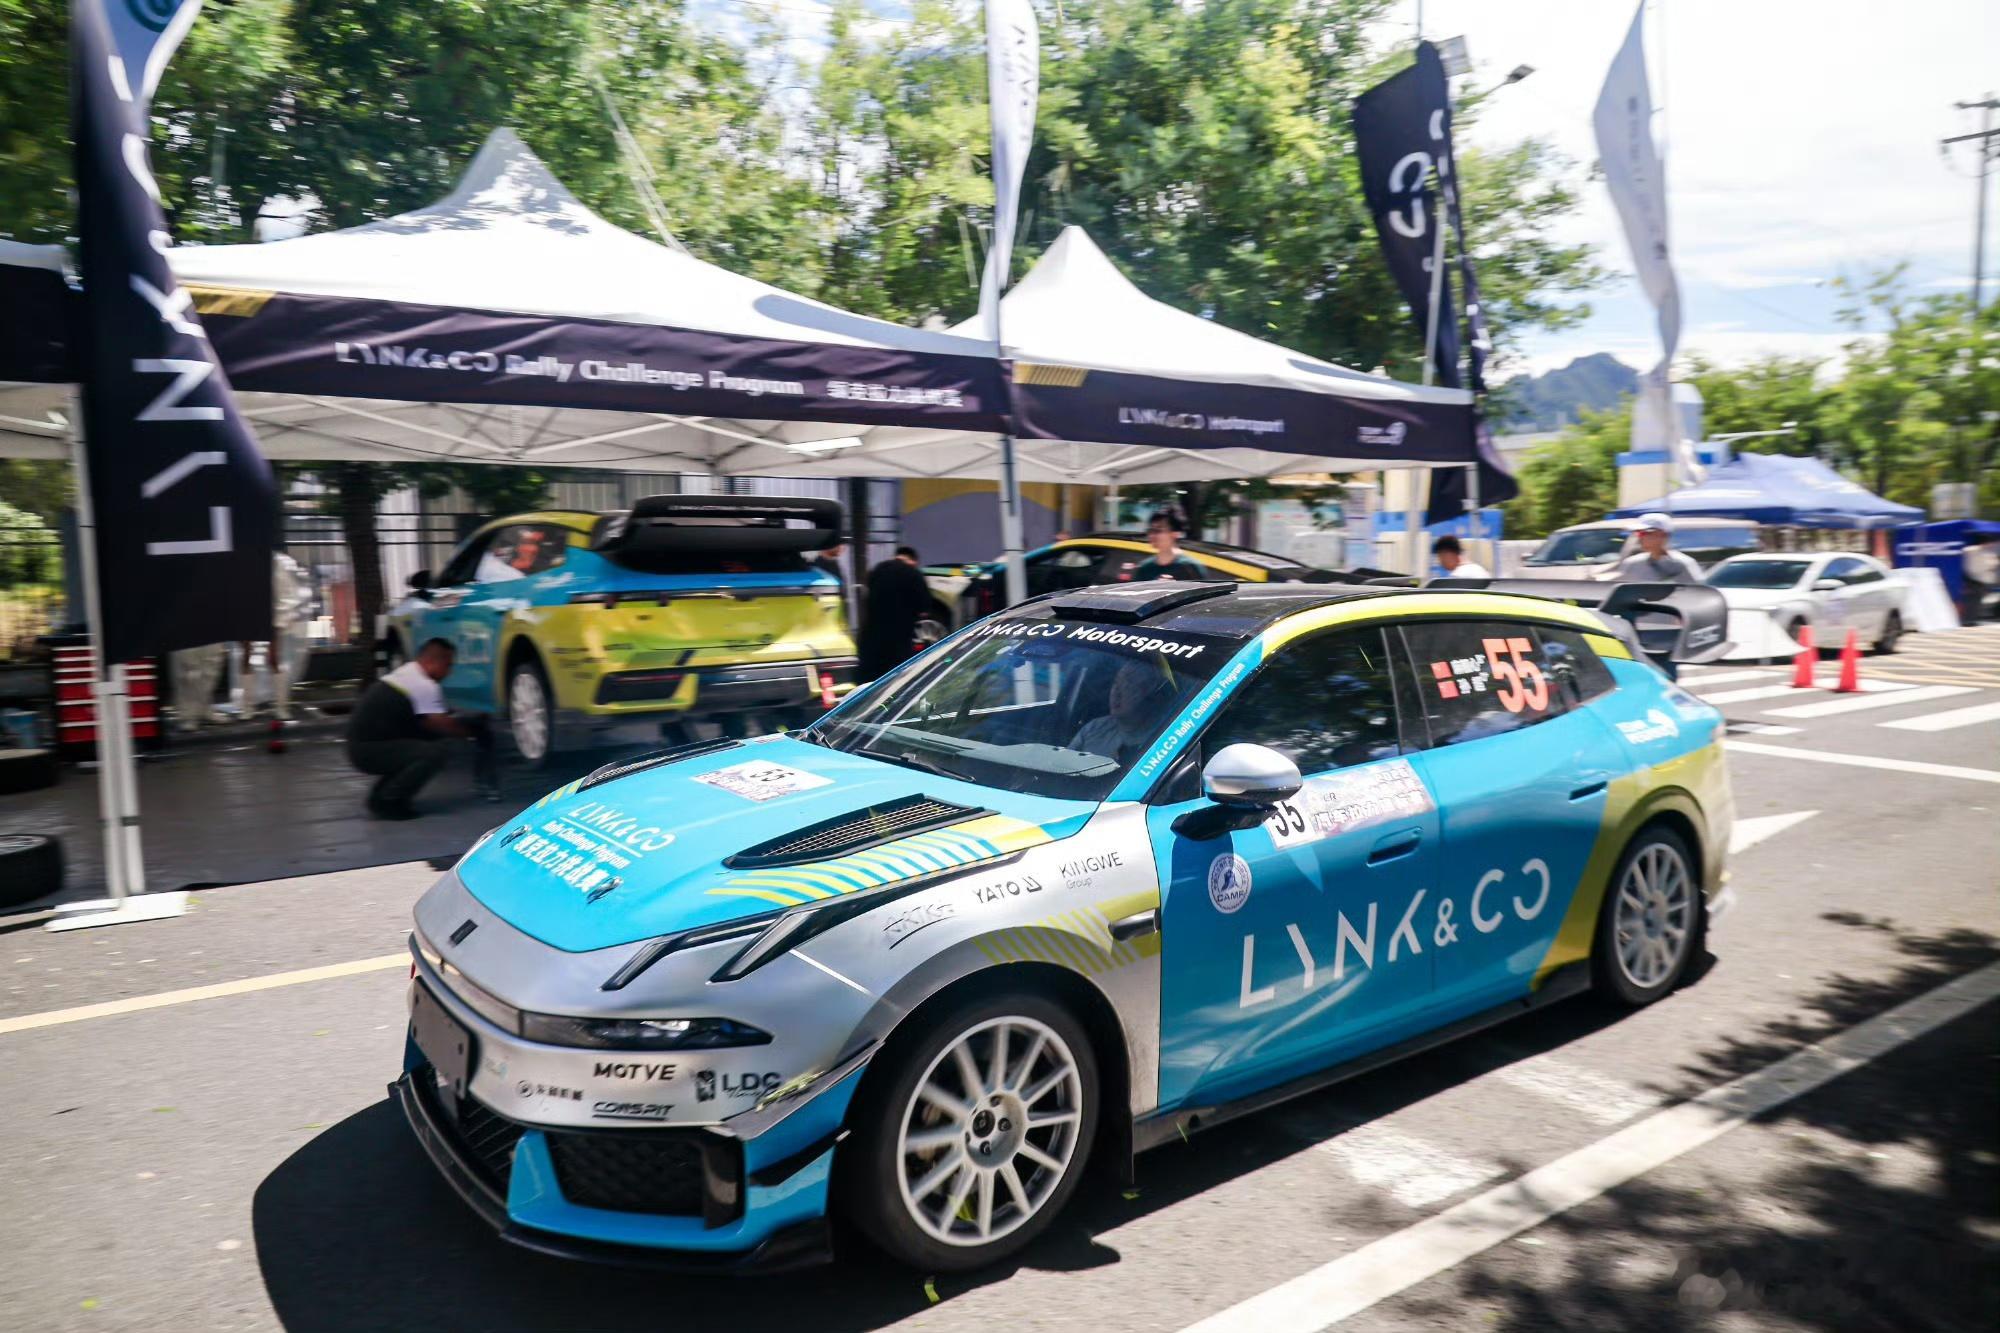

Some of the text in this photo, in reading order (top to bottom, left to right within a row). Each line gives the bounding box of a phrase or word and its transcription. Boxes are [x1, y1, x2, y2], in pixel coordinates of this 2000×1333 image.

[1067, 625, 1207, 659] Motorsport
[1481, 637, 1549, 713] 55
[1175, 718, 1195, 739] Rally
[1191, 686, 1223, 720] Challenge
[1220, 662, 1247, 689] Program
[749, 768, 795, 783] 55
[567, 801, 677, 852] LYNK&CO
[1058, 852, 1123, 880] KINGWE
[972, 880, 1021, 904] YATO
[1066, 877, 1093, 891] Group
[1239, 857, 1551, 1009] LYNK&CO
